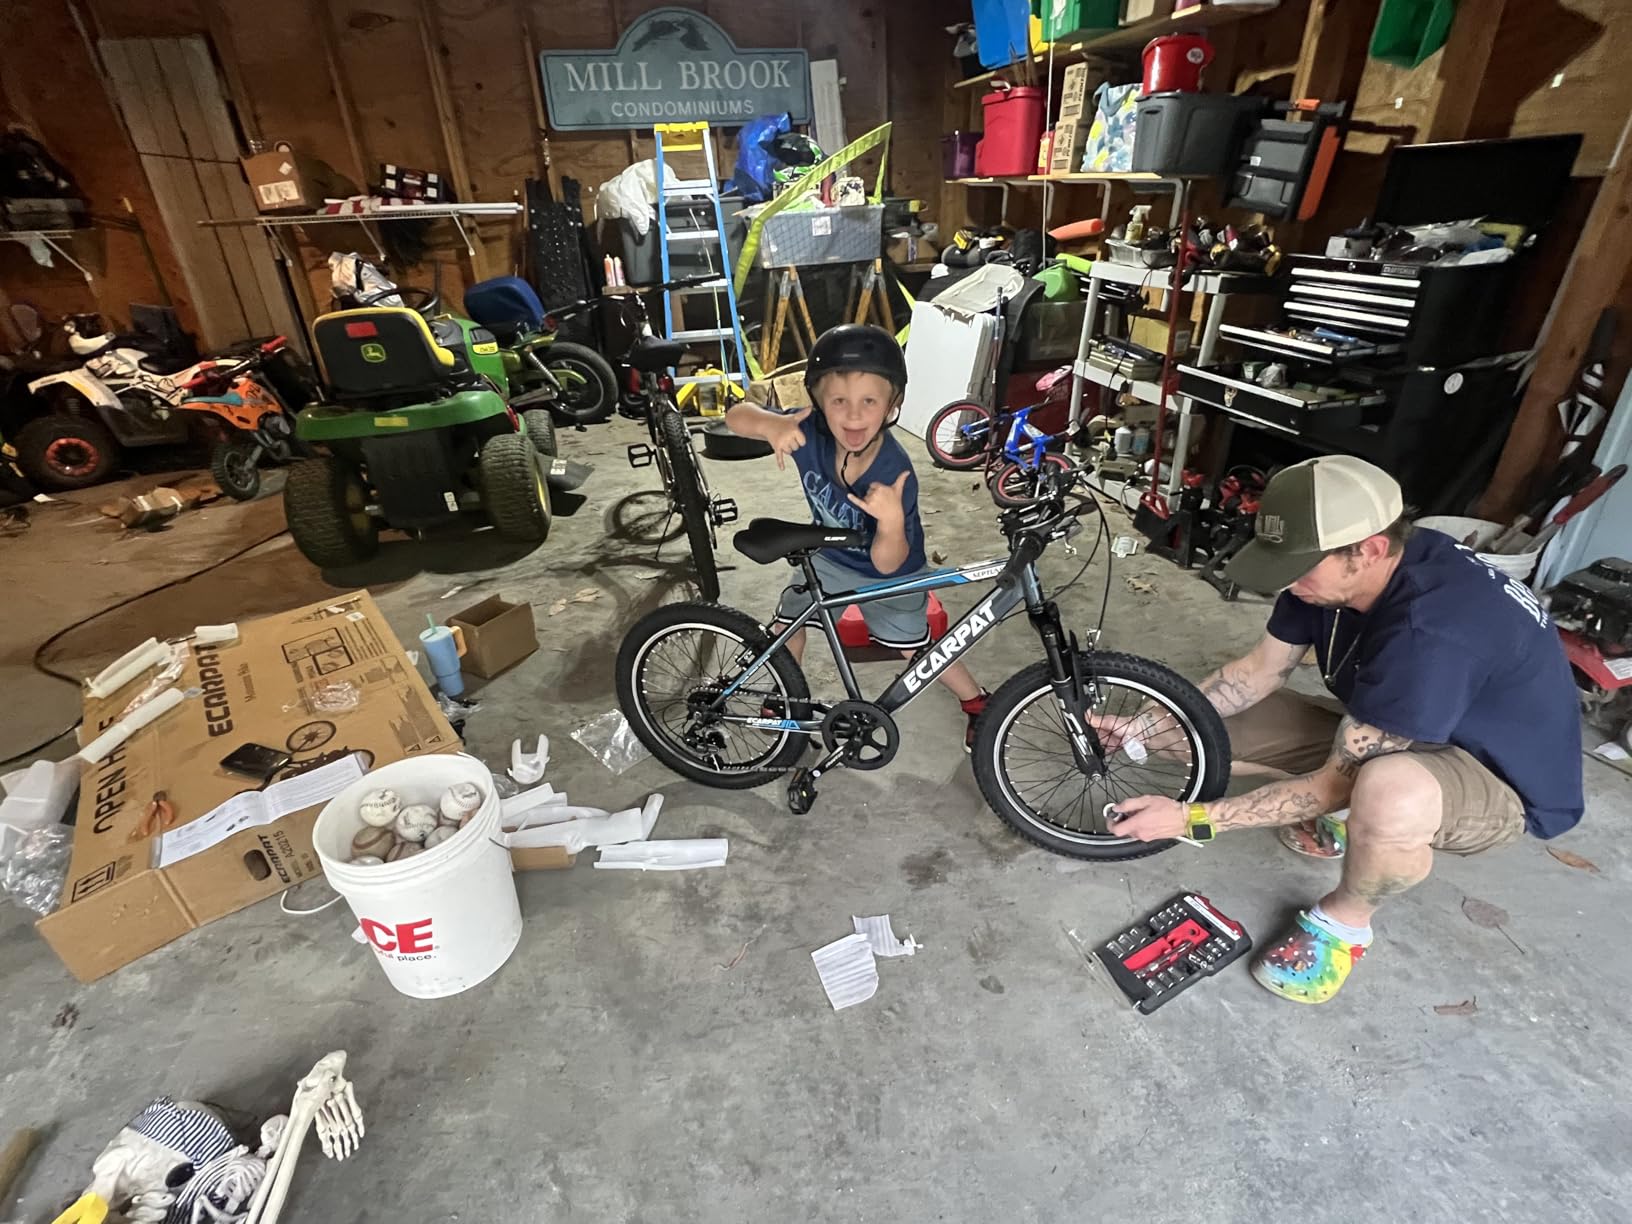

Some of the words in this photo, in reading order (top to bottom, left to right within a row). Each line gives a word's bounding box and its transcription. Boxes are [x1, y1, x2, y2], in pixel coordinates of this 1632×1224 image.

[564, 61, 662, 91] MILL
[678, 60, 791, 90] BROOK
[611, 100, 755, 117] CONDOMINIUMS
[903, 600, 995, 693] ECARPAT
[194, 645, 234, 737] ECARPAT
[747, 717, 782, 727] ECARPAT
[93, 765, 128, 834] OPEN
[257, 834, 291, 883] ECARPAT
[360, 917, 433, 954] CE
